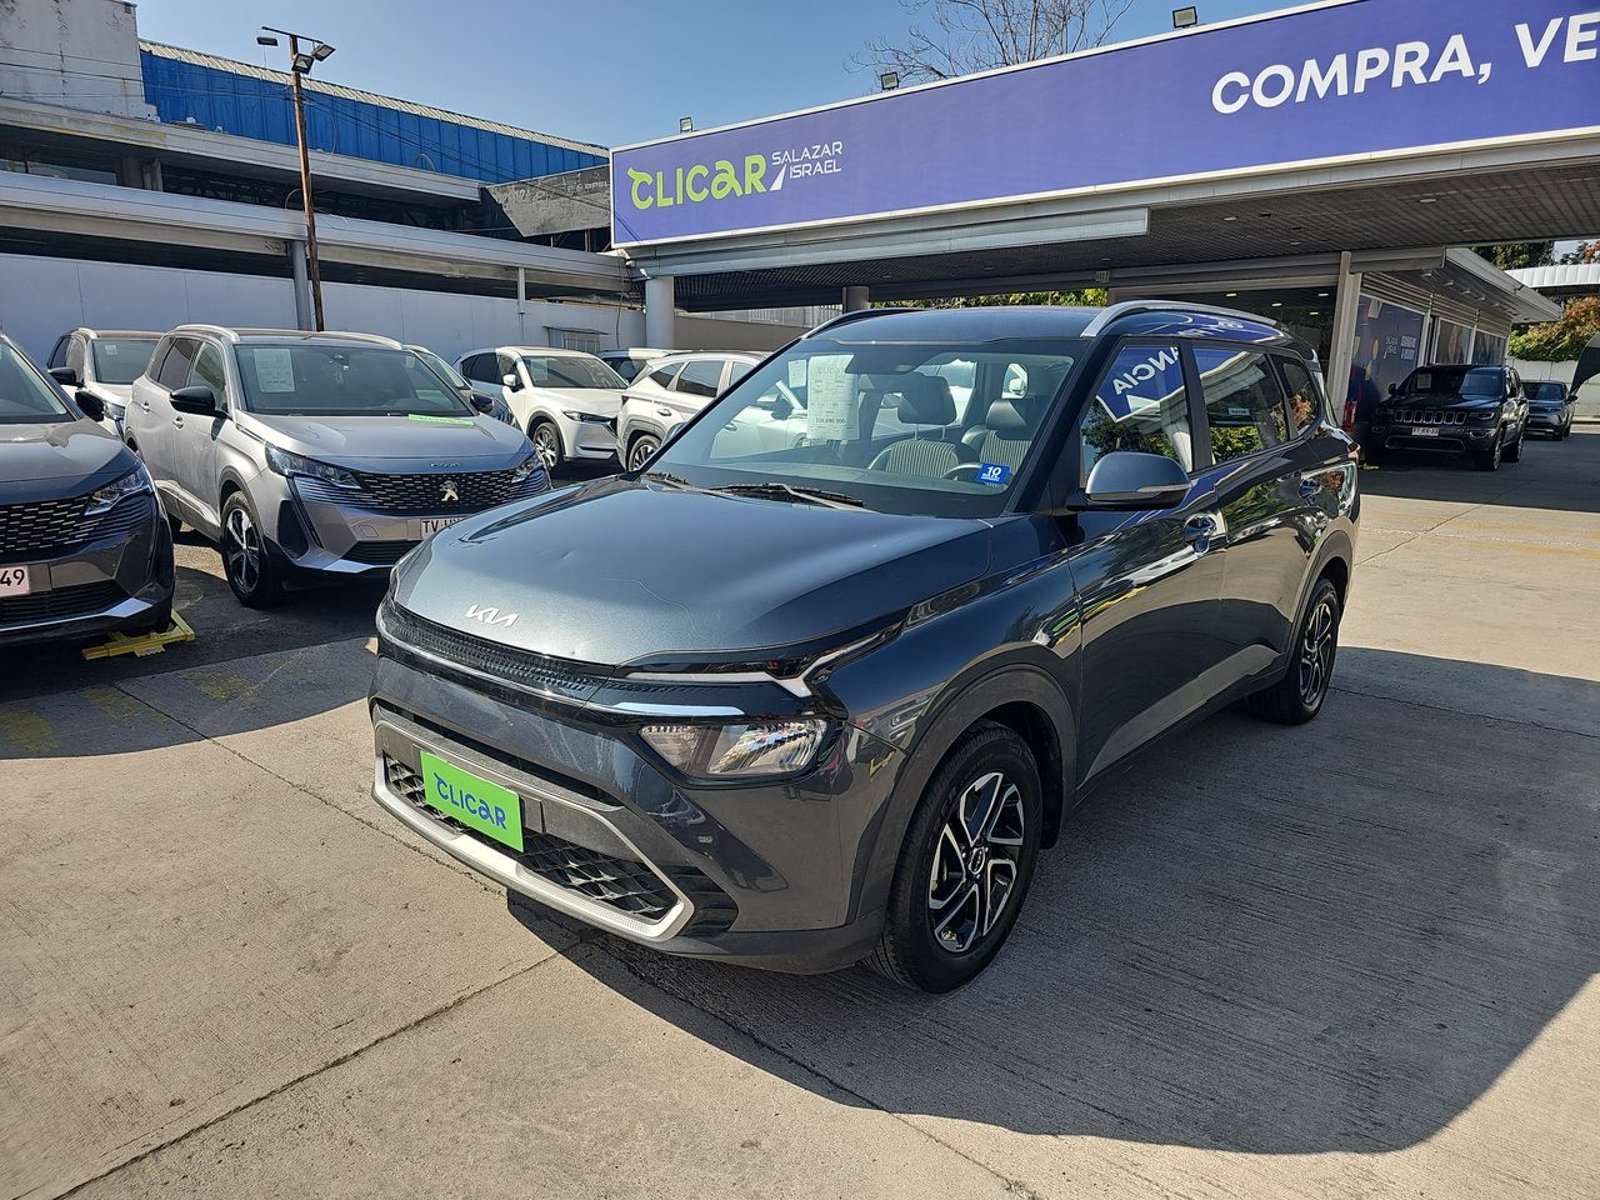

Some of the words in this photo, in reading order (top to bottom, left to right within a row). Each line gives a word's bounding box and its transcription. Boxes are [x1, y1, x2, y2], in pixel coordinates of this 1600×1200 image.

[1211, 33, 1492, 115] COMPRA,
[771, 140, 844, 167] SALAZAR
[788, 158, 842, 180] ISRAEL
[986, 465, 1002, 477] 10
[0, 568, 25, 587] 49
